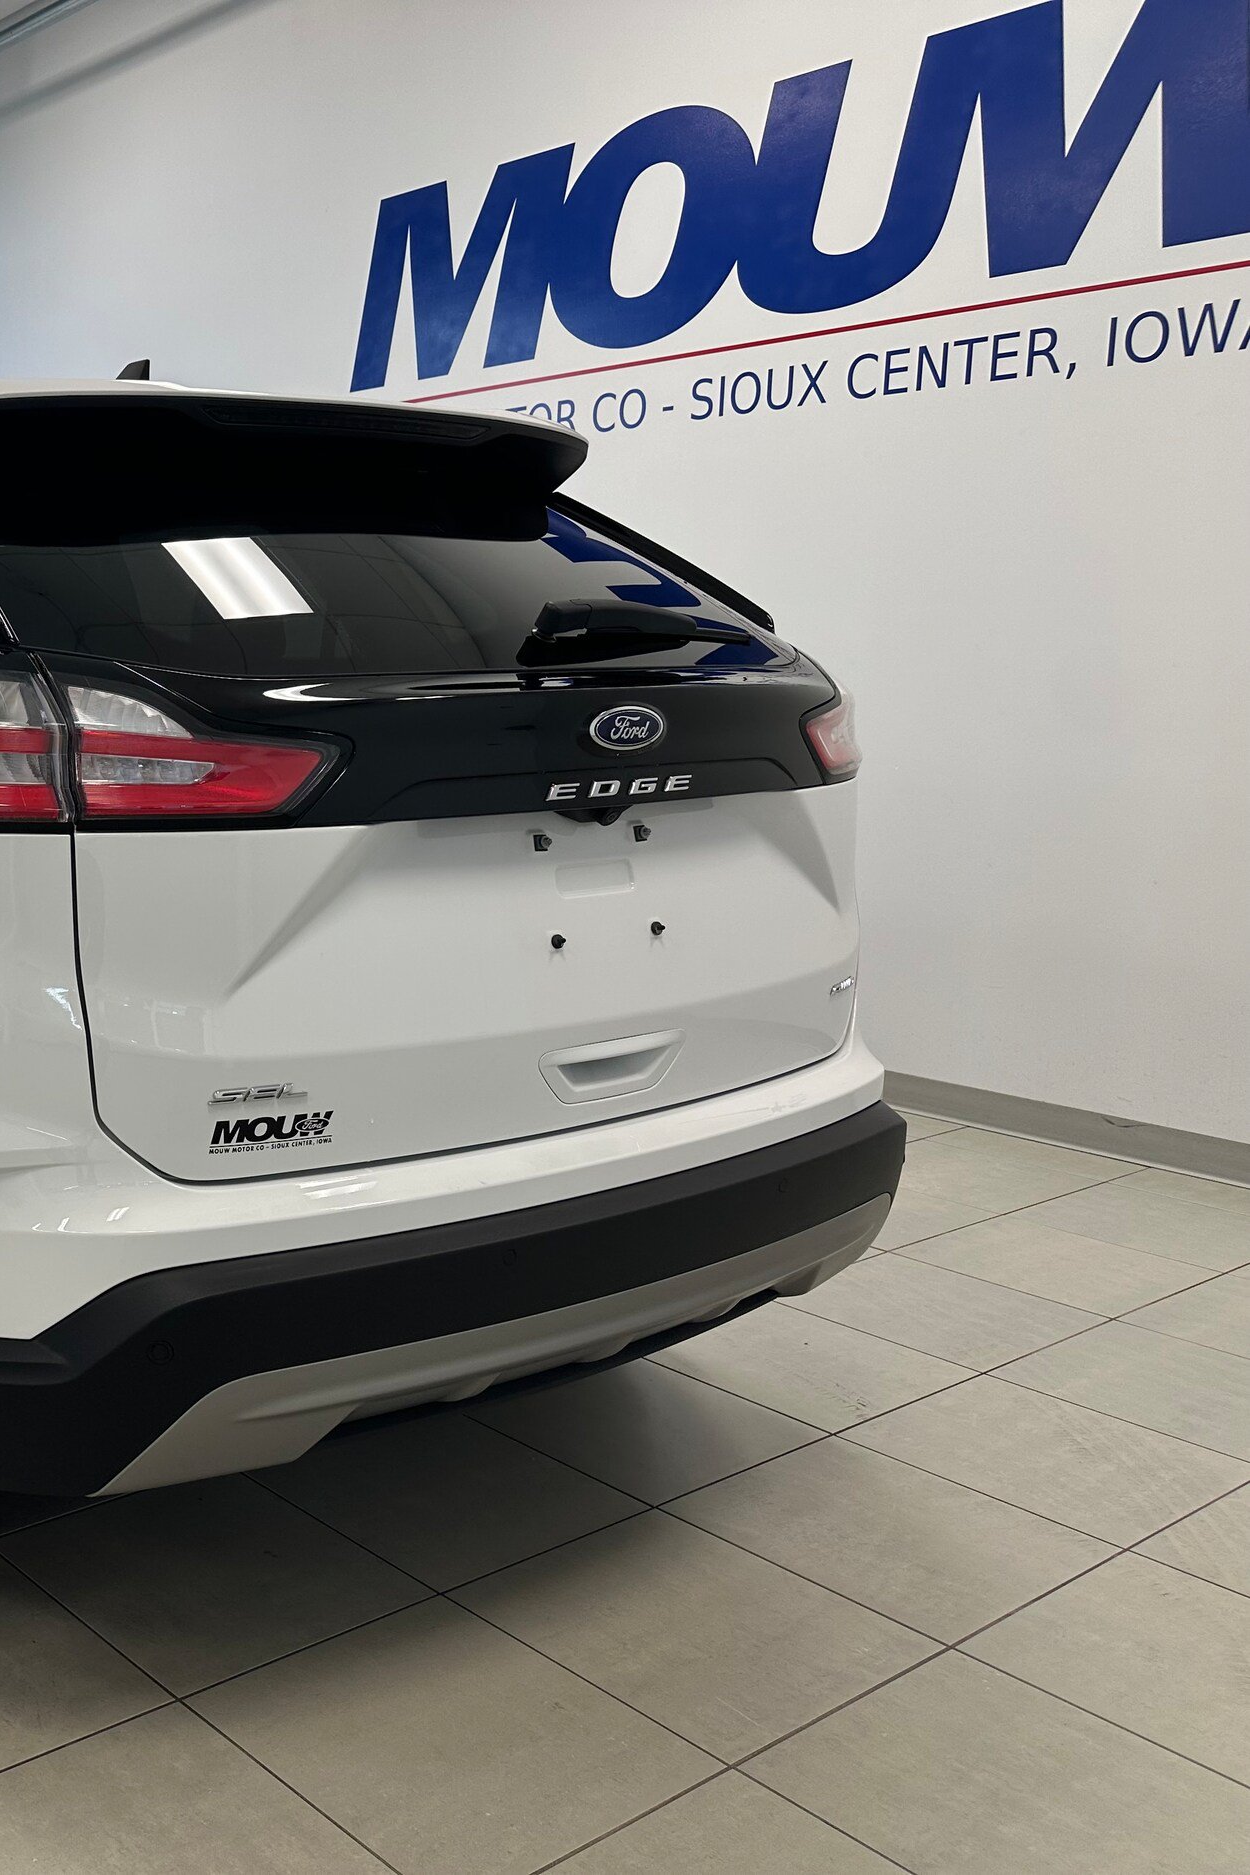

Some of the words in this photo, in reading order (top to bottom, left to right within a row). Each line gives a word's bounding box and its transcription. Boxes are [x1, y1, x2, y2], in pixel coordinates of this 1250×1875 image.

[592, 388, 647, 432] CO
[690, 360, 829, 421] SIOUX
[846, 327, 1077, 400] CENTER,
[1106, 298, 1250, 367] IOW
[545, 774, 693, 802] EDGE
[207, 1082, 308, 1106] SEL
[271, 1142, 290, 1150] SIOUX
